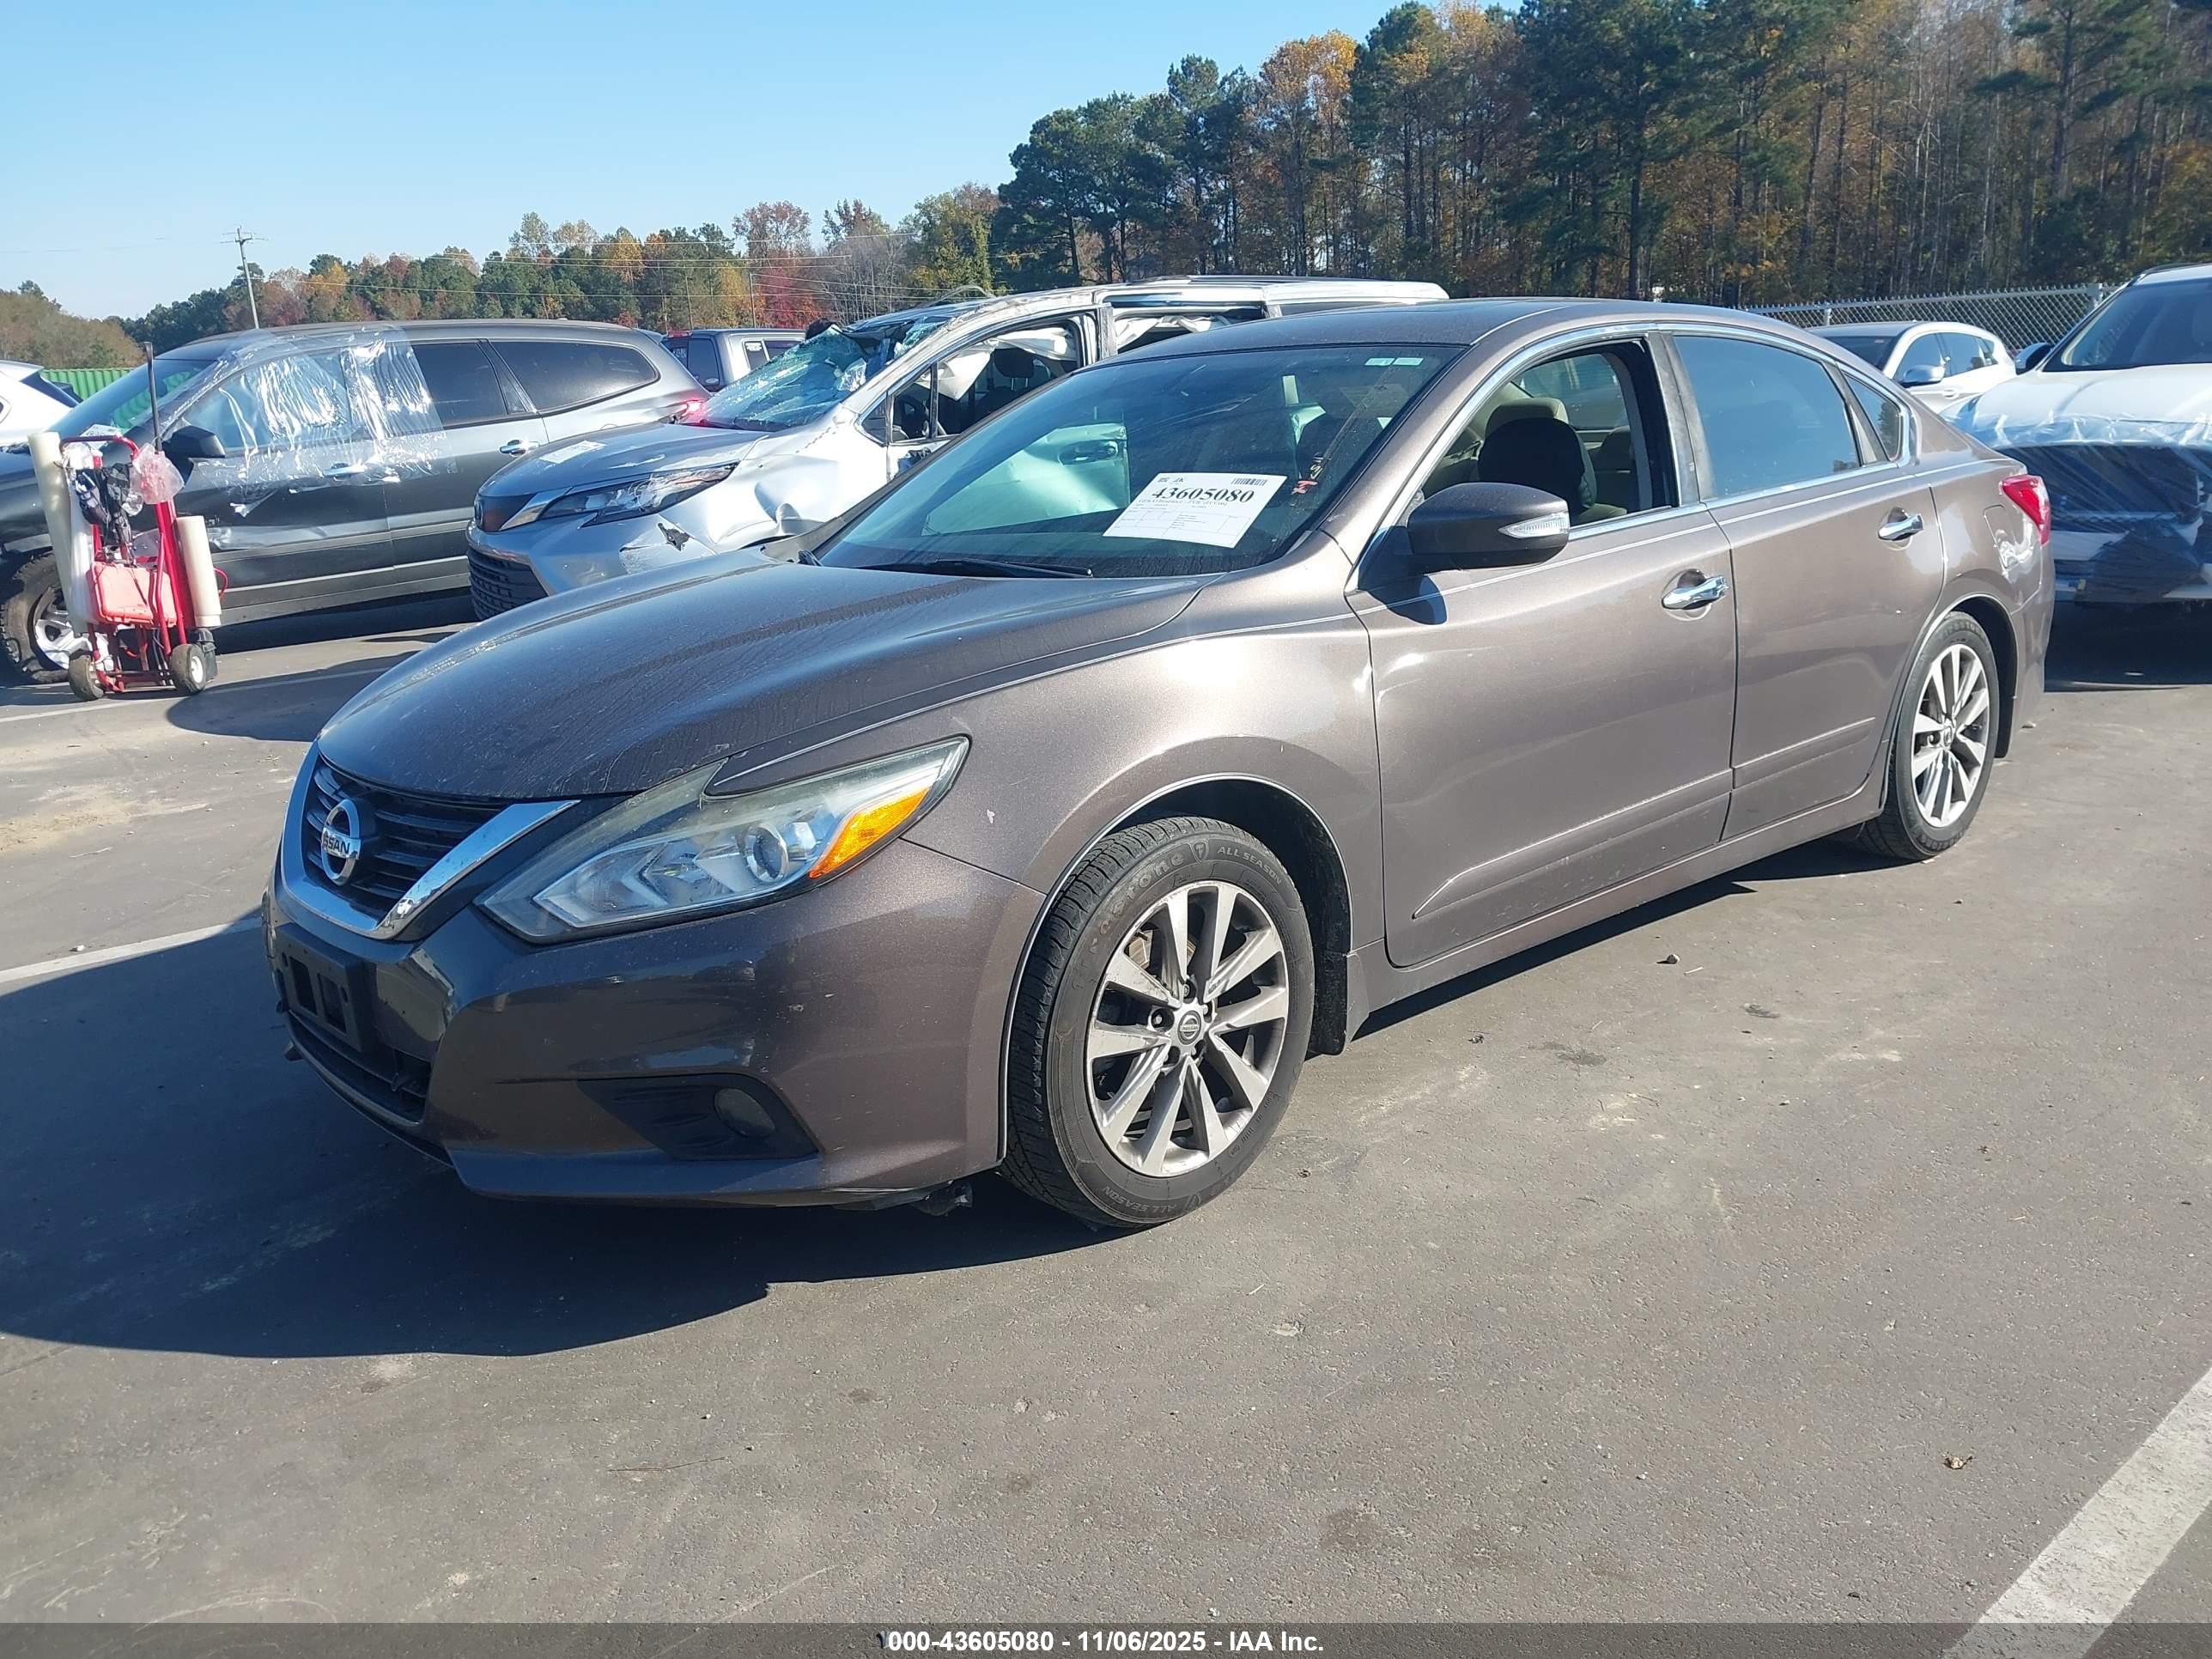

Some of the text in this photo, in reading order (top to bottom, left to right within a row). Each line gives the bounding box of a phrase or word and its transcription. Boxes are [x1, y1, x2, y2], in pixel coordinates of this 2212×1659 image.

[1152, 487, 1255, 502] 43605080
[1218, 846, 1282, 884] ALL SEASON
[1102, 1186, 1177, 1213] ALL SEASON
